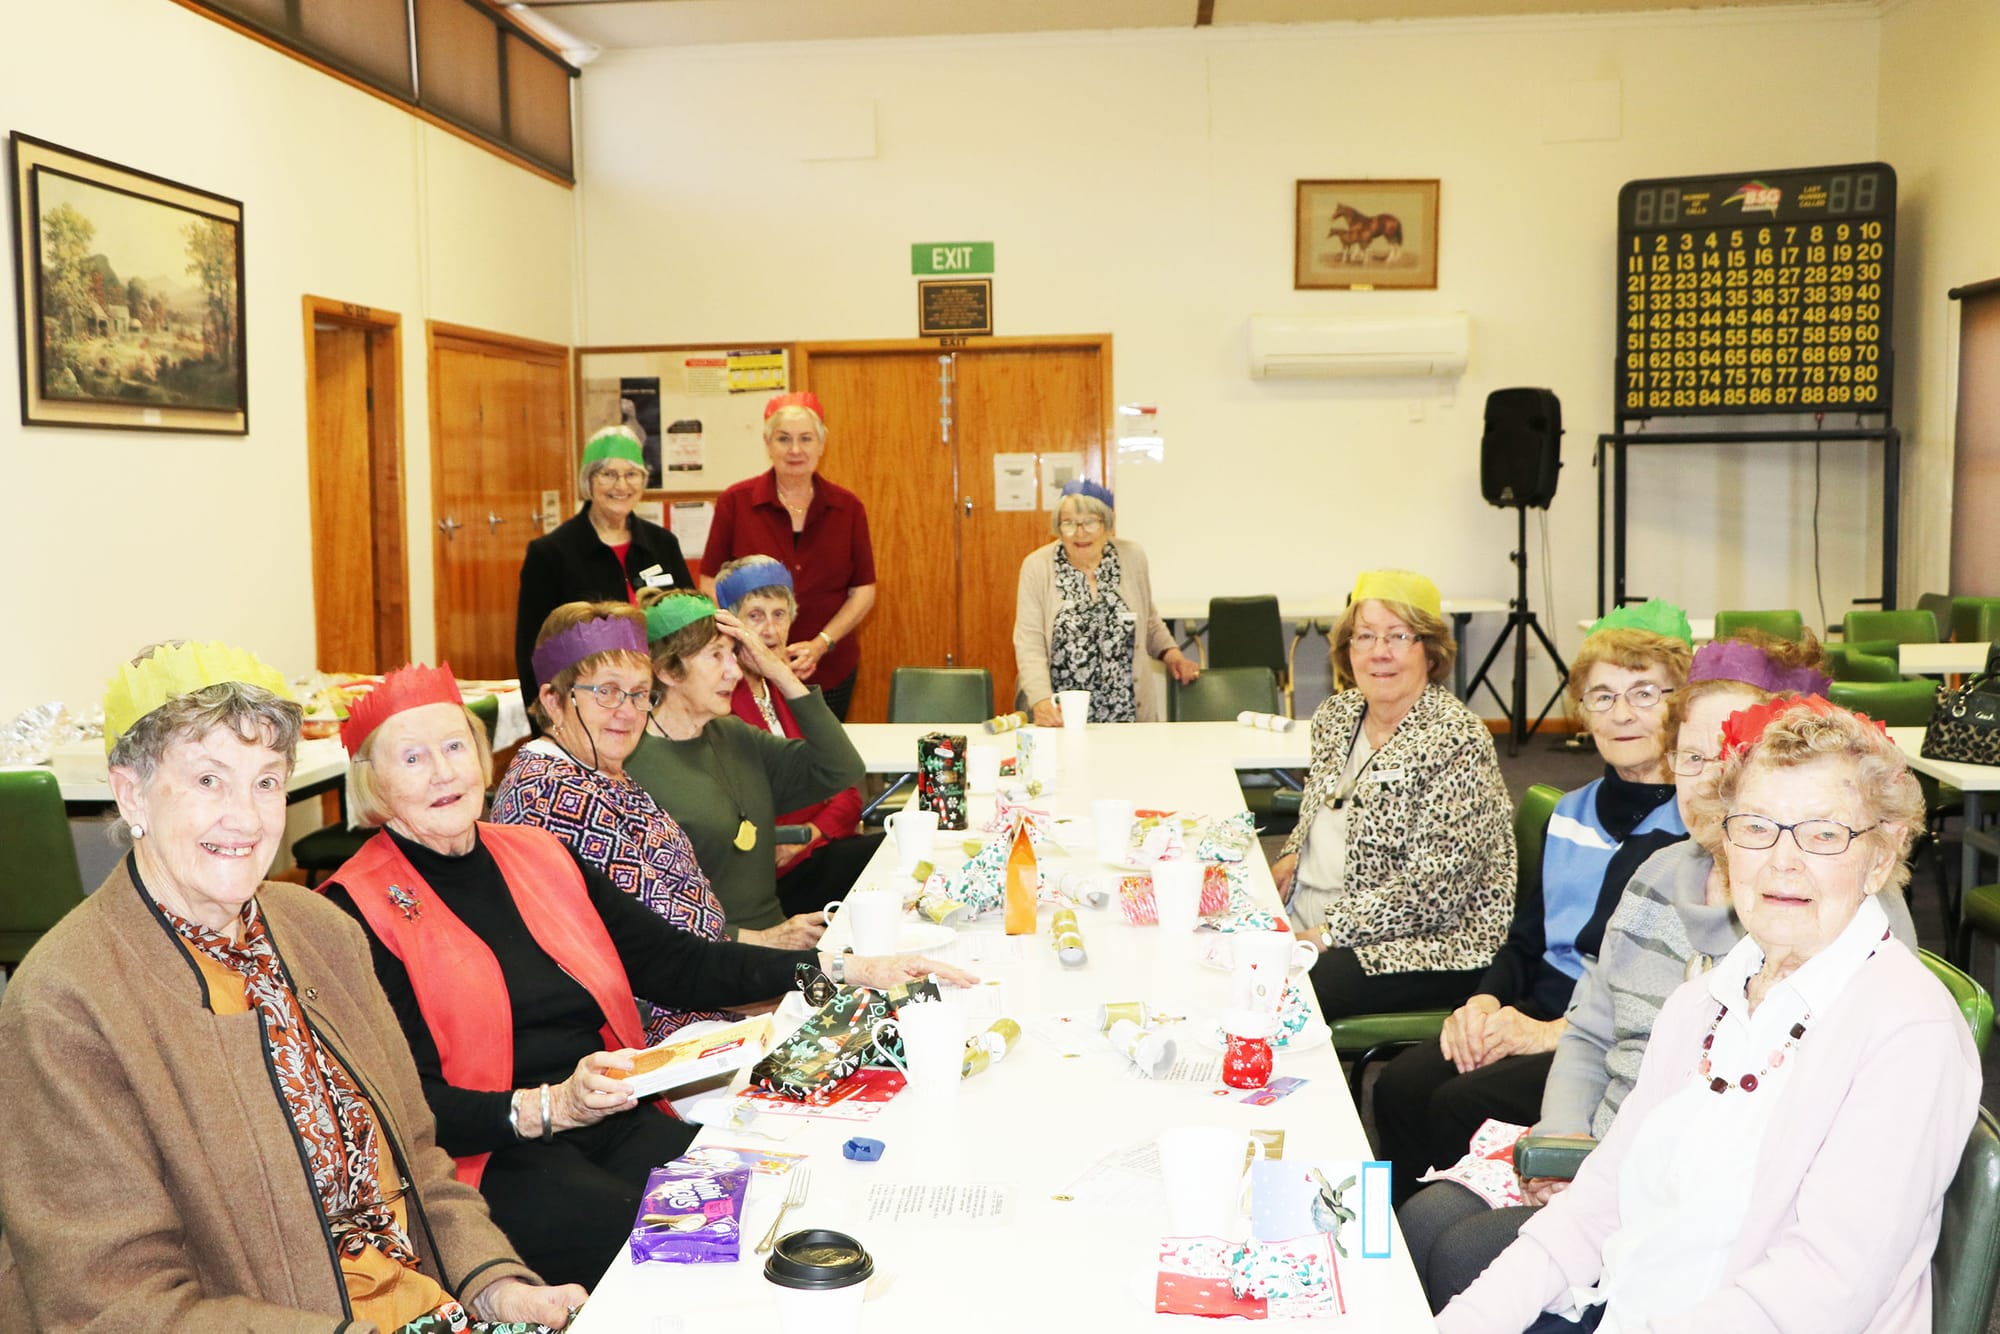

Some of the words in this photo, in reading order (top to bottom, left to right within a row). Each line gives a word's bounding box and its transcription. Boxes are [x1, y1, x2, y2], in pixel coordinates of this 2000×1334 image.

[1634, 237, 1640, 253] 1
[1657, 236, 1667, 252] 2
[1681, 234, 1692, 250] 3
[1706, 232, 1717, 248] 4
[1732, 230, 1743, 247] 5
[1759, 228, 1771, 245] 6
[1786, 227, 1796, 243] 7
[1811, 226, 1823, 242] 8
[1837, 224, 1850, 241] 9
[1859, 222, 1881, 239] 10
[932, 247, 973, 270] EXIT
[1630, 256, 1643, 272] 11
[1652, 255, 1670, 272] 12
[1677, 253, 1695, 270] 13
[1702, 252, 1720, 268] 14
[1728, 250, 1746, 267] 15
[1755, 248, 1774, 265] 16
[1781, 247, 1799, 264] 17
[1808, 246, 1826, 262] 18
[1834, 244, 1852, 261] 19
[1857, 243, 1883, 260] 20
[1628, 275, 1645, 292] 21
[1651, 274, 1673, 290] 22
[1676, 272, 1698, 289] 23
[1700, 271, 1722, 288] 24
[1726, 269, 1748, 287] 25
[1753, 268, 1775, 286] 26
[1779, 267, 1800, 284] 27
[1804, 266, 1827, 283] 28
[1831, 265, 1854, 282] 29
[1858, 264, 1881, 280] 30
[1629, 295, 1645, 311] 31
[1651, 293, 1672, 310] 32
[1676, 292, 1697, 309] 33
[1701, 291, 1722, 307] 34
[1726, 289, 1748, 306] 35
[1752, 288, 1774, 305] 36
[1778, 287, 1800, 304] 37
[1805, 286, 1827, 303] 38
[1830, 285, 1853, 302] 39
[1857, 284, 1880, 300] 40
[1628, 314, 1644, 329] 41
[1650, 313, 1672, 329] 42
[1675, 312, 1697, 328] 43
[1700, 311, 1722, 326] 44
[1725, 309, 1748, 326] 45
[1752, 308, 1774, 324] 46
[1777, 307, 1799, 324] 47
[1803, 306, 1827, 323] 48
[1829, 305, 1853, 322] 49
[1857, 304, 1880, 321] 50
[940, 337, 968, 347] EXIT
[1628, 333, 1644, 350] 51
[1650, 332, 1672, 349] 52
[1675, 331, 1697, 348] 53
[1700, 330, 1722, 347] 54
[1726, 329, 1748, 346] 55
[1751, 328, 1774, 344] 56
[1777, 327, 1799, 344] 57
[1804, 327, 1826, 343] 58
[1829, 326, 1852, 342] 59
[1856, 324, 1879, 341] 60
[1628, 353, 1644, 369] 61
[1650, 352, 1671, 368] 62
[1674, 351, 1696, 367] 63
[1699, 350, 1722, 366] 64
[1725, 349, 1747, 365] 65
[1750, 348, 1773, 365] 66
[1776, 347, 1798, 364] 67
[1803, 346, 1825, 363] 68
[1828, 345, 1852, 362] 69
[1856, 345, 1878, 361] 70
[1629, 372, 1644, 387] 71
[1651, 371, 1671, 387] 72
[1676, 370, 1696, 386] 73
[1701, 370, 1721, 385] 74
[1726, 368, 1747, 384] 75
[1751, 368, 1772, 384] 76
[1777, 367, 1798, 383] 77
[1803, 366, 1825, 383] 78
[1829, 366, 1851, 382] 79
[1854, 365, 1878, 382] 80
[1628, 392, 1644, 407] 81
[1650, 390, 1671, 407] 82
[1674, 390, 1696, 406] 83
[1698, 390, 1721, 405] 84
[1724, 388, 1747, 404] 85
[1750, 387, 1772, 404] 86
[1776, 387, 1798, 403] 87
[1801, 387, 1824, 403] 88
[1828, 386, 1851, 402] 89
[1854, 385, 1877, 401] 90
